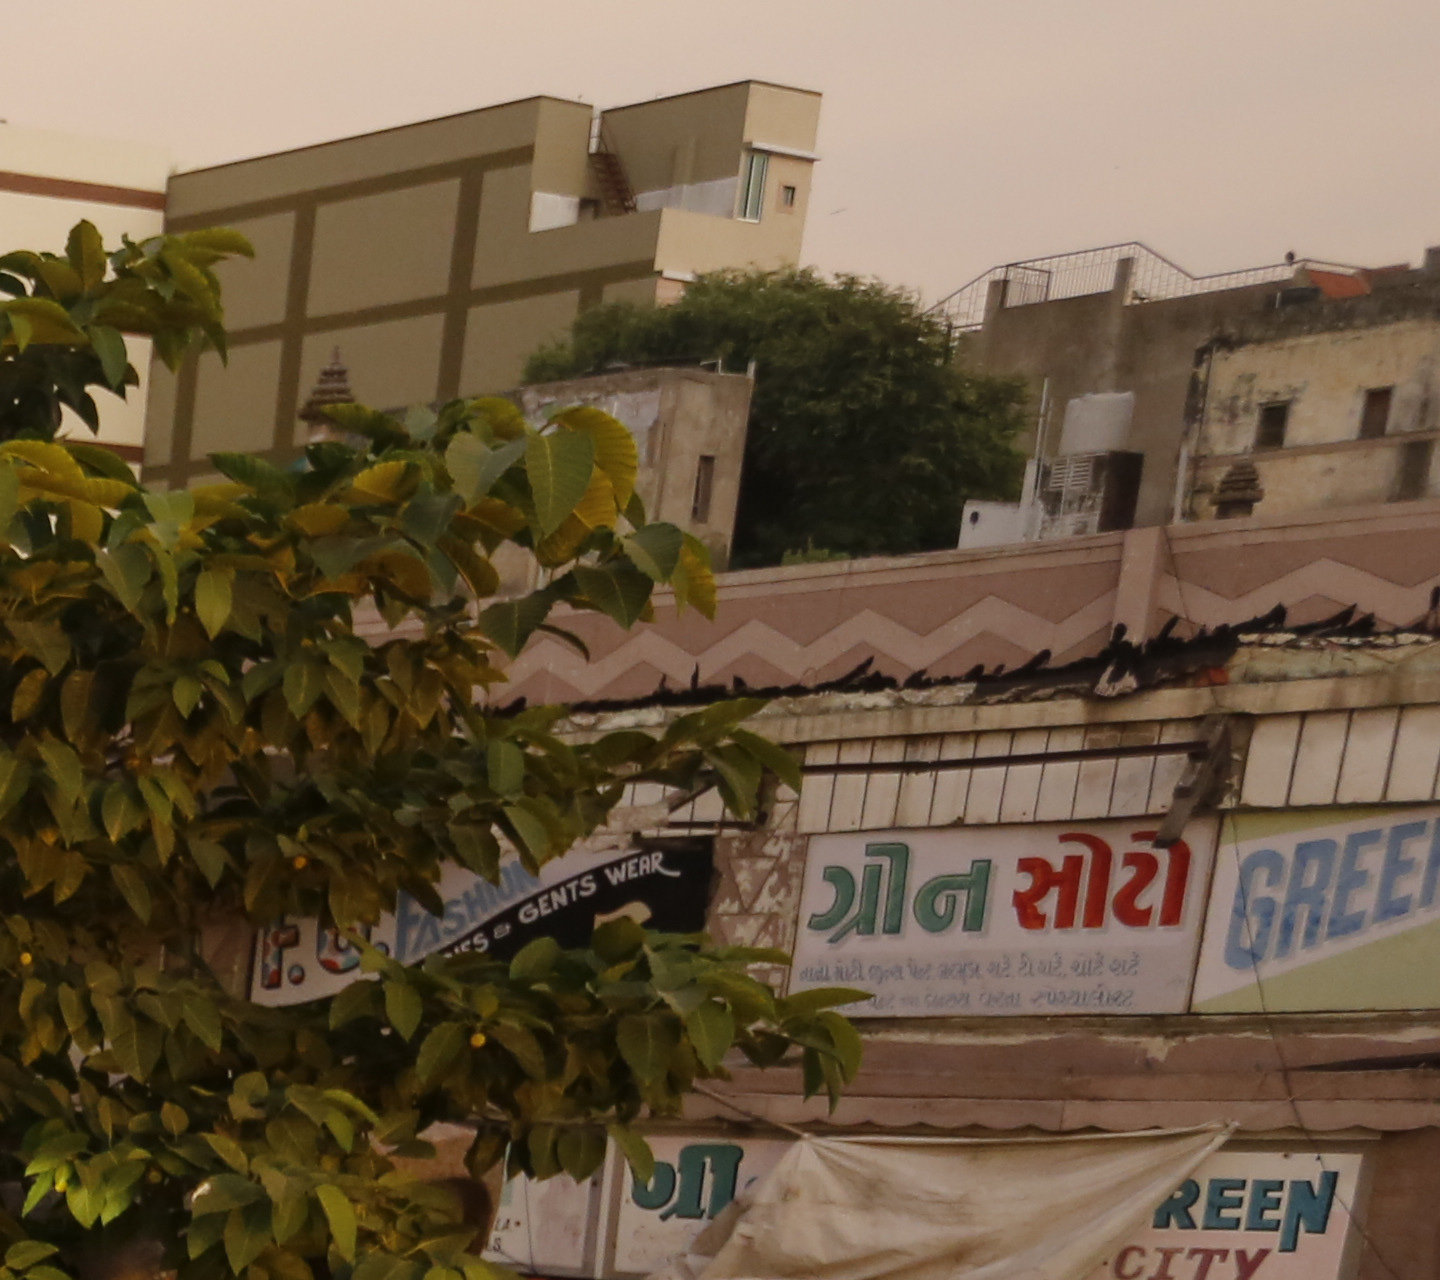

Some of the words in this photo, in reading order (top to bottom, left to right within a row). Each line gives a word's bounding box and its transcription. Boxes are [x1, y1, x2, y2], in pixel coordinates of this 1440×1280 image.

[517, 874, 597, 926] GENTS
[604, 851, 681, 887] WEAR
[807, 842, 992, 944] ગ્રીન
[1012, 831, 1191, 930] સીટી
[1152, 1170, 1339, 1252] REEN
